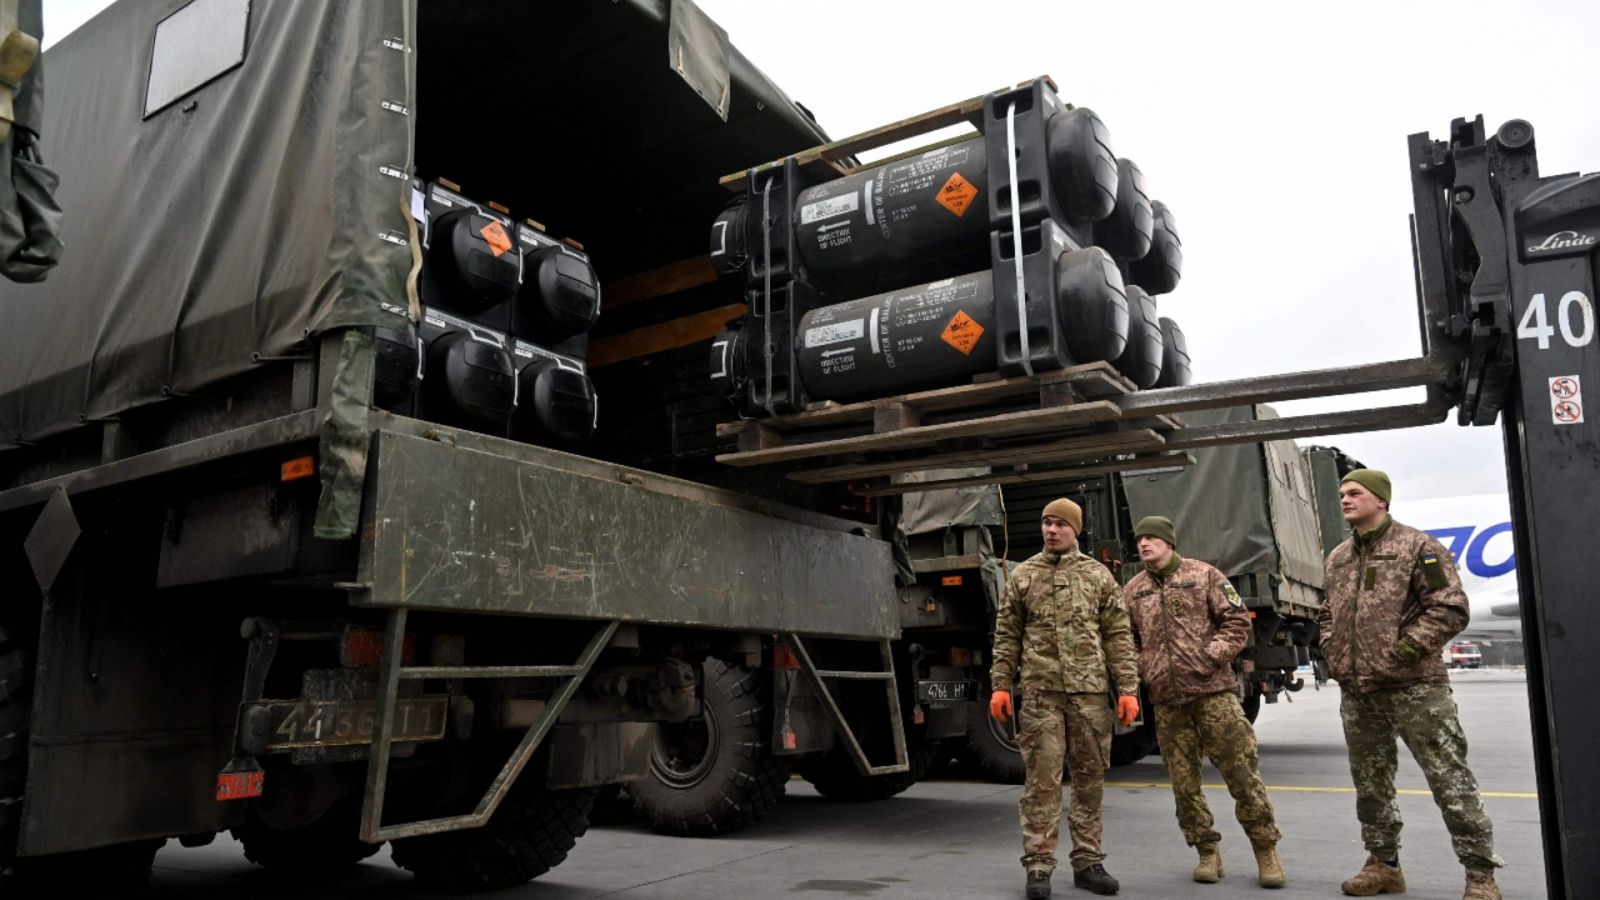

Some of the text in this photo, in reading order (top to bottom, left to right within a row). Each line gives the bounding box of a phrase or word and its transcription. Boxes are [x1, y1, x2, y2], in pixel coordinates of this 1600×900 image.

[817, 228, 851, 243] DIRECTION
[830, 235, 853, 249] FLIGHT
[1528, 231, 1595, 252] Linde
[1517, 291, 1595, 349] 40
[820, 355, 854, 368] DIRECTION
[833, 362, 856, 374] FLIGHT
